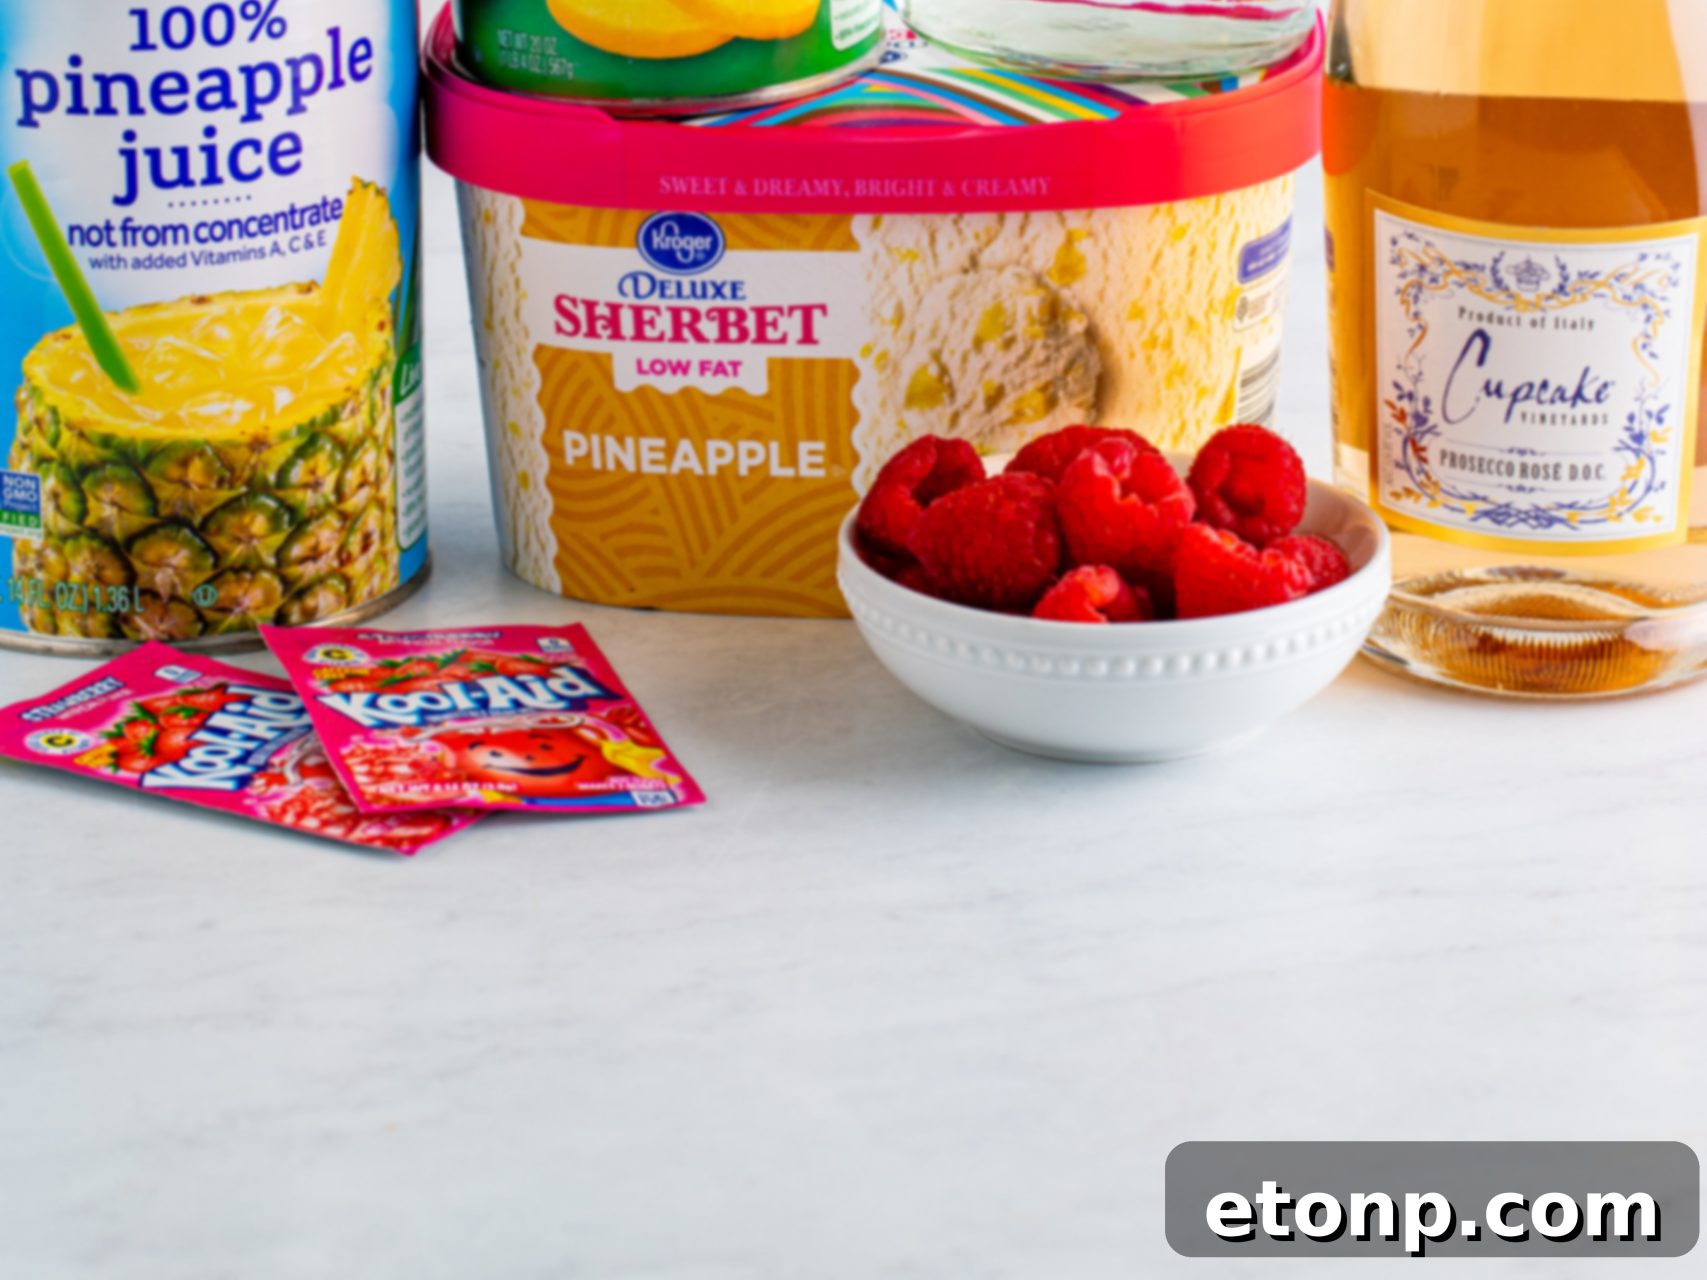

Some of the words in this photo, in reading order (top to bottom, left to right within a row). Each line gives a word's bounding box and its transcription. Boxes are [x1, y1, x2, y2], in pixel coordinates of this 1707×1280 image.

[14, 25, 375, 129] pineapple
[113, 125, 304, 208] juice
[658, 176, 729, 196] SWEET
[734, 179, 748, 196] &
[753, 177, 851, 199] DREAMY,
[854, 177, 936, 198] BRIGHT
[942, 180, 956, 197] &
[961, 176, 1052, 197] CREAMY
[68, 218, 117, 248] not
[119, 216, 190, 248] from
[193, 195, 344, 245] concentrate
[651, 220, 713, 264] Kroger
[88, 252, 128, 272] with
[131, 251, 188, 272] added
[189, 242, 267, 268] Vitamins
[268, 240, 287, 259] A,
[288, 234, 301, 255] C
[302, 232, 316, 251] &
[316, 228, 327, 248] E
[553, 293, 828, 346] SHERBET
[1458, 305, 1522, 327] Product
[1529, 316, 1547, 330] of
[1553, 316, 1595, 331] Italy
[635, 357, 692, 377] LOW
[697, 359, 743, 378] FAT
[1441, 327, 1616, 425] Cupcake
[1520, 410, 1609, 426] VINEYARDS
[562, 429, 827, 478] PINEAPPLE
[1439, 448, 1516, 478] PROSECCO
[2, 474, 36, 490] NON
[2, 487, 38, 503] GMO
[94, 584, 131, 613] 1.36
[134, 585, 145, 613] L
[316, 665, 603, 727] Kool-Aid
[141, 684, 305, 791] Kool-Aid
